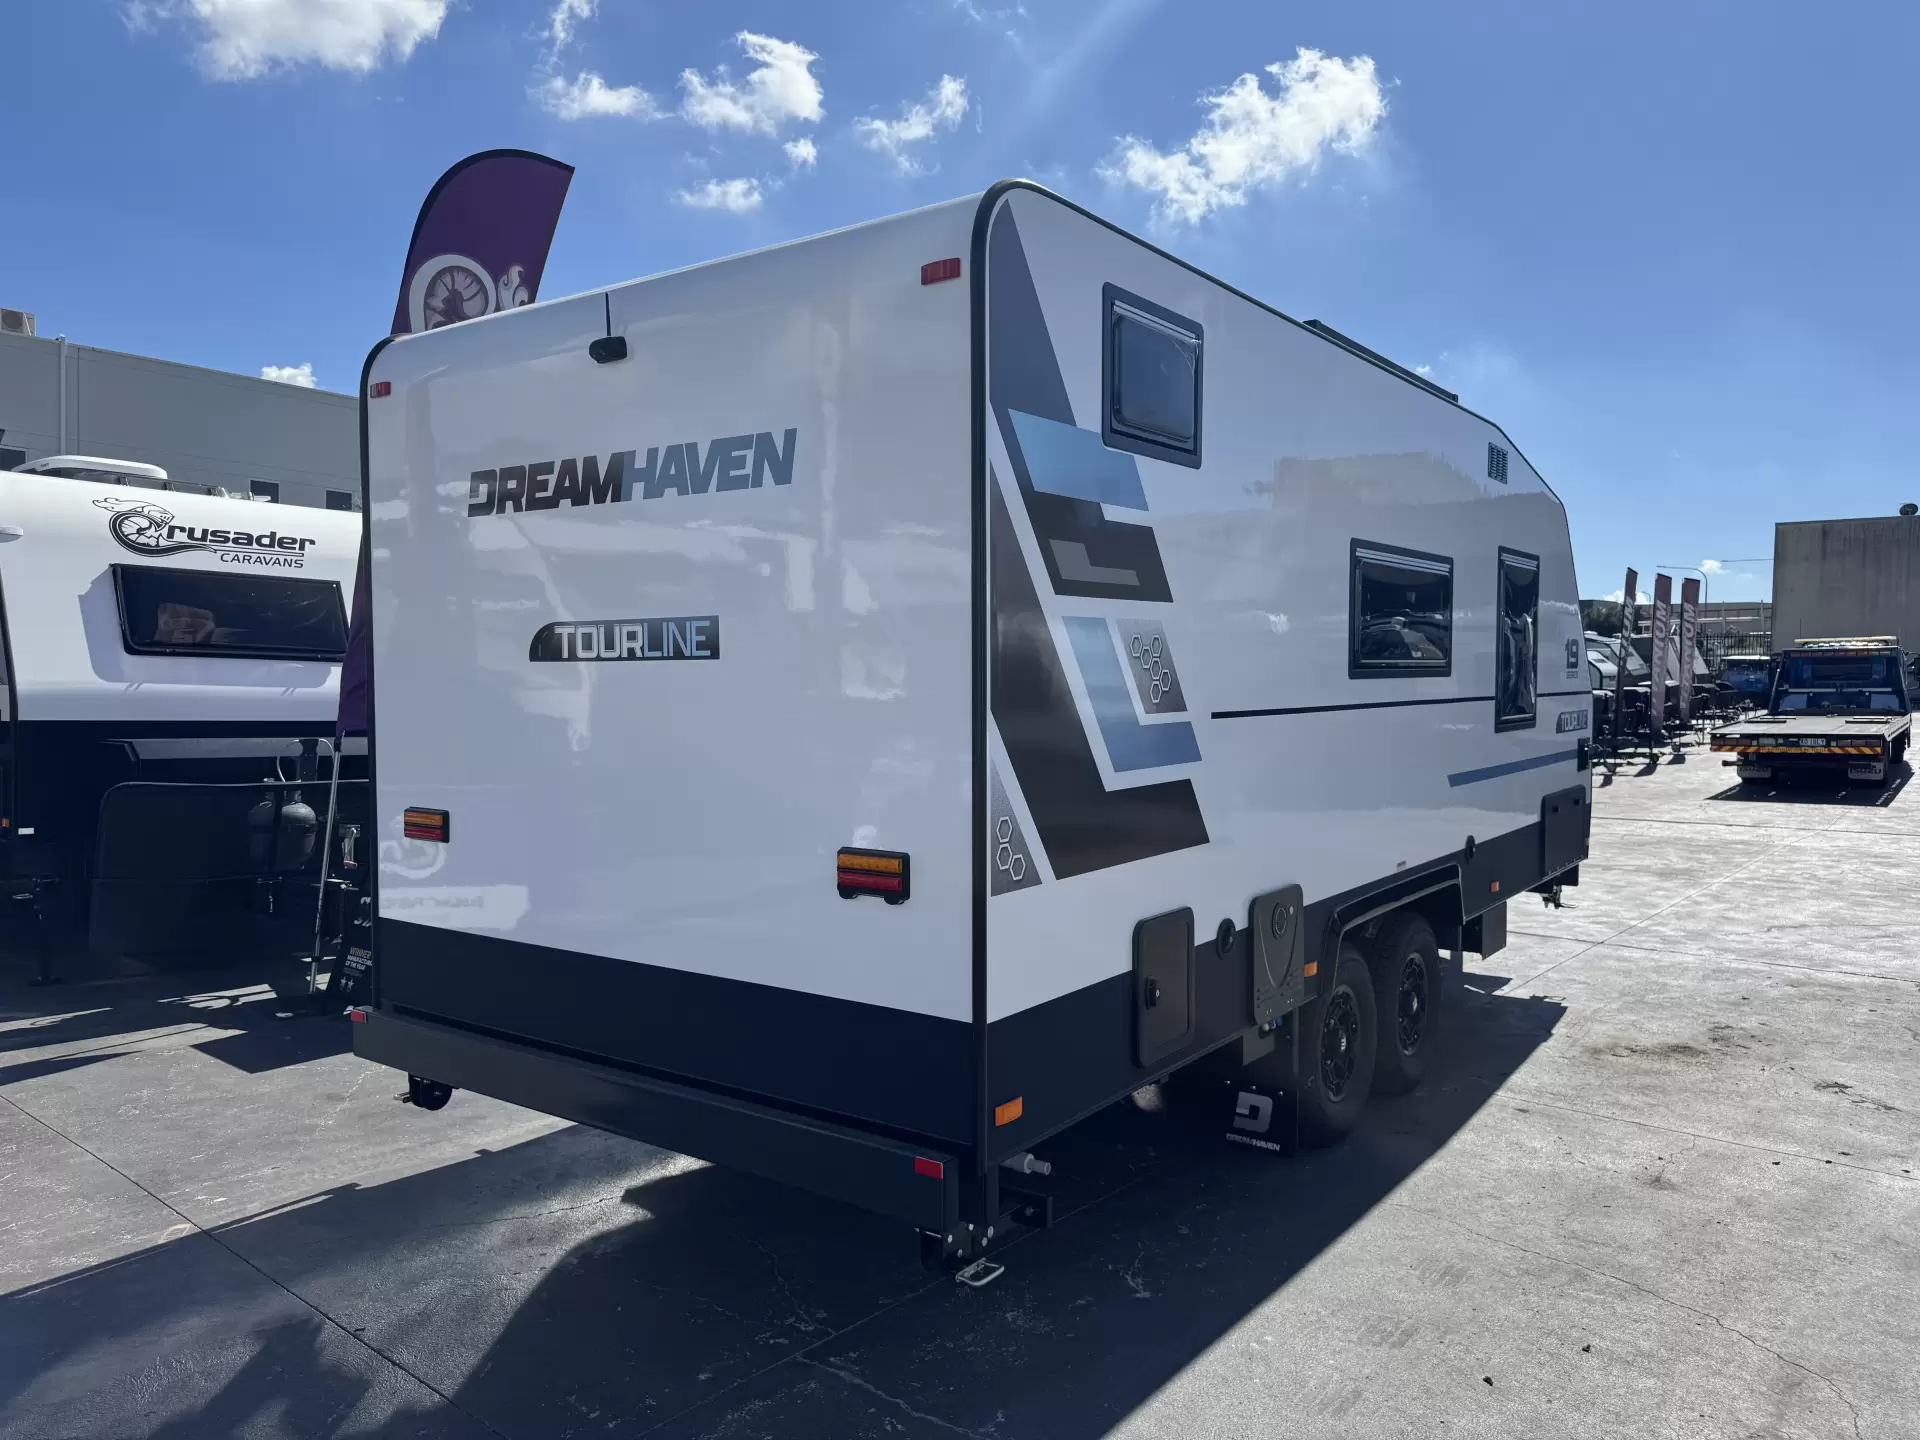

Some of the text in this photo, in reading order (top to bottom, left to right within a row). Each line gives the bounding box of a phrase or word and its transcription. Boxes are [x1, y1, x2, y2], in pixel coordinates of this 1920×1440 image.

[468, 428, 797, 517] DREAMHAVEN
[220, 553, 304, 568] CARAVANS
[554, 620, 711, 659] TOURLINE
[1565, 639, 1579, 669] 19
